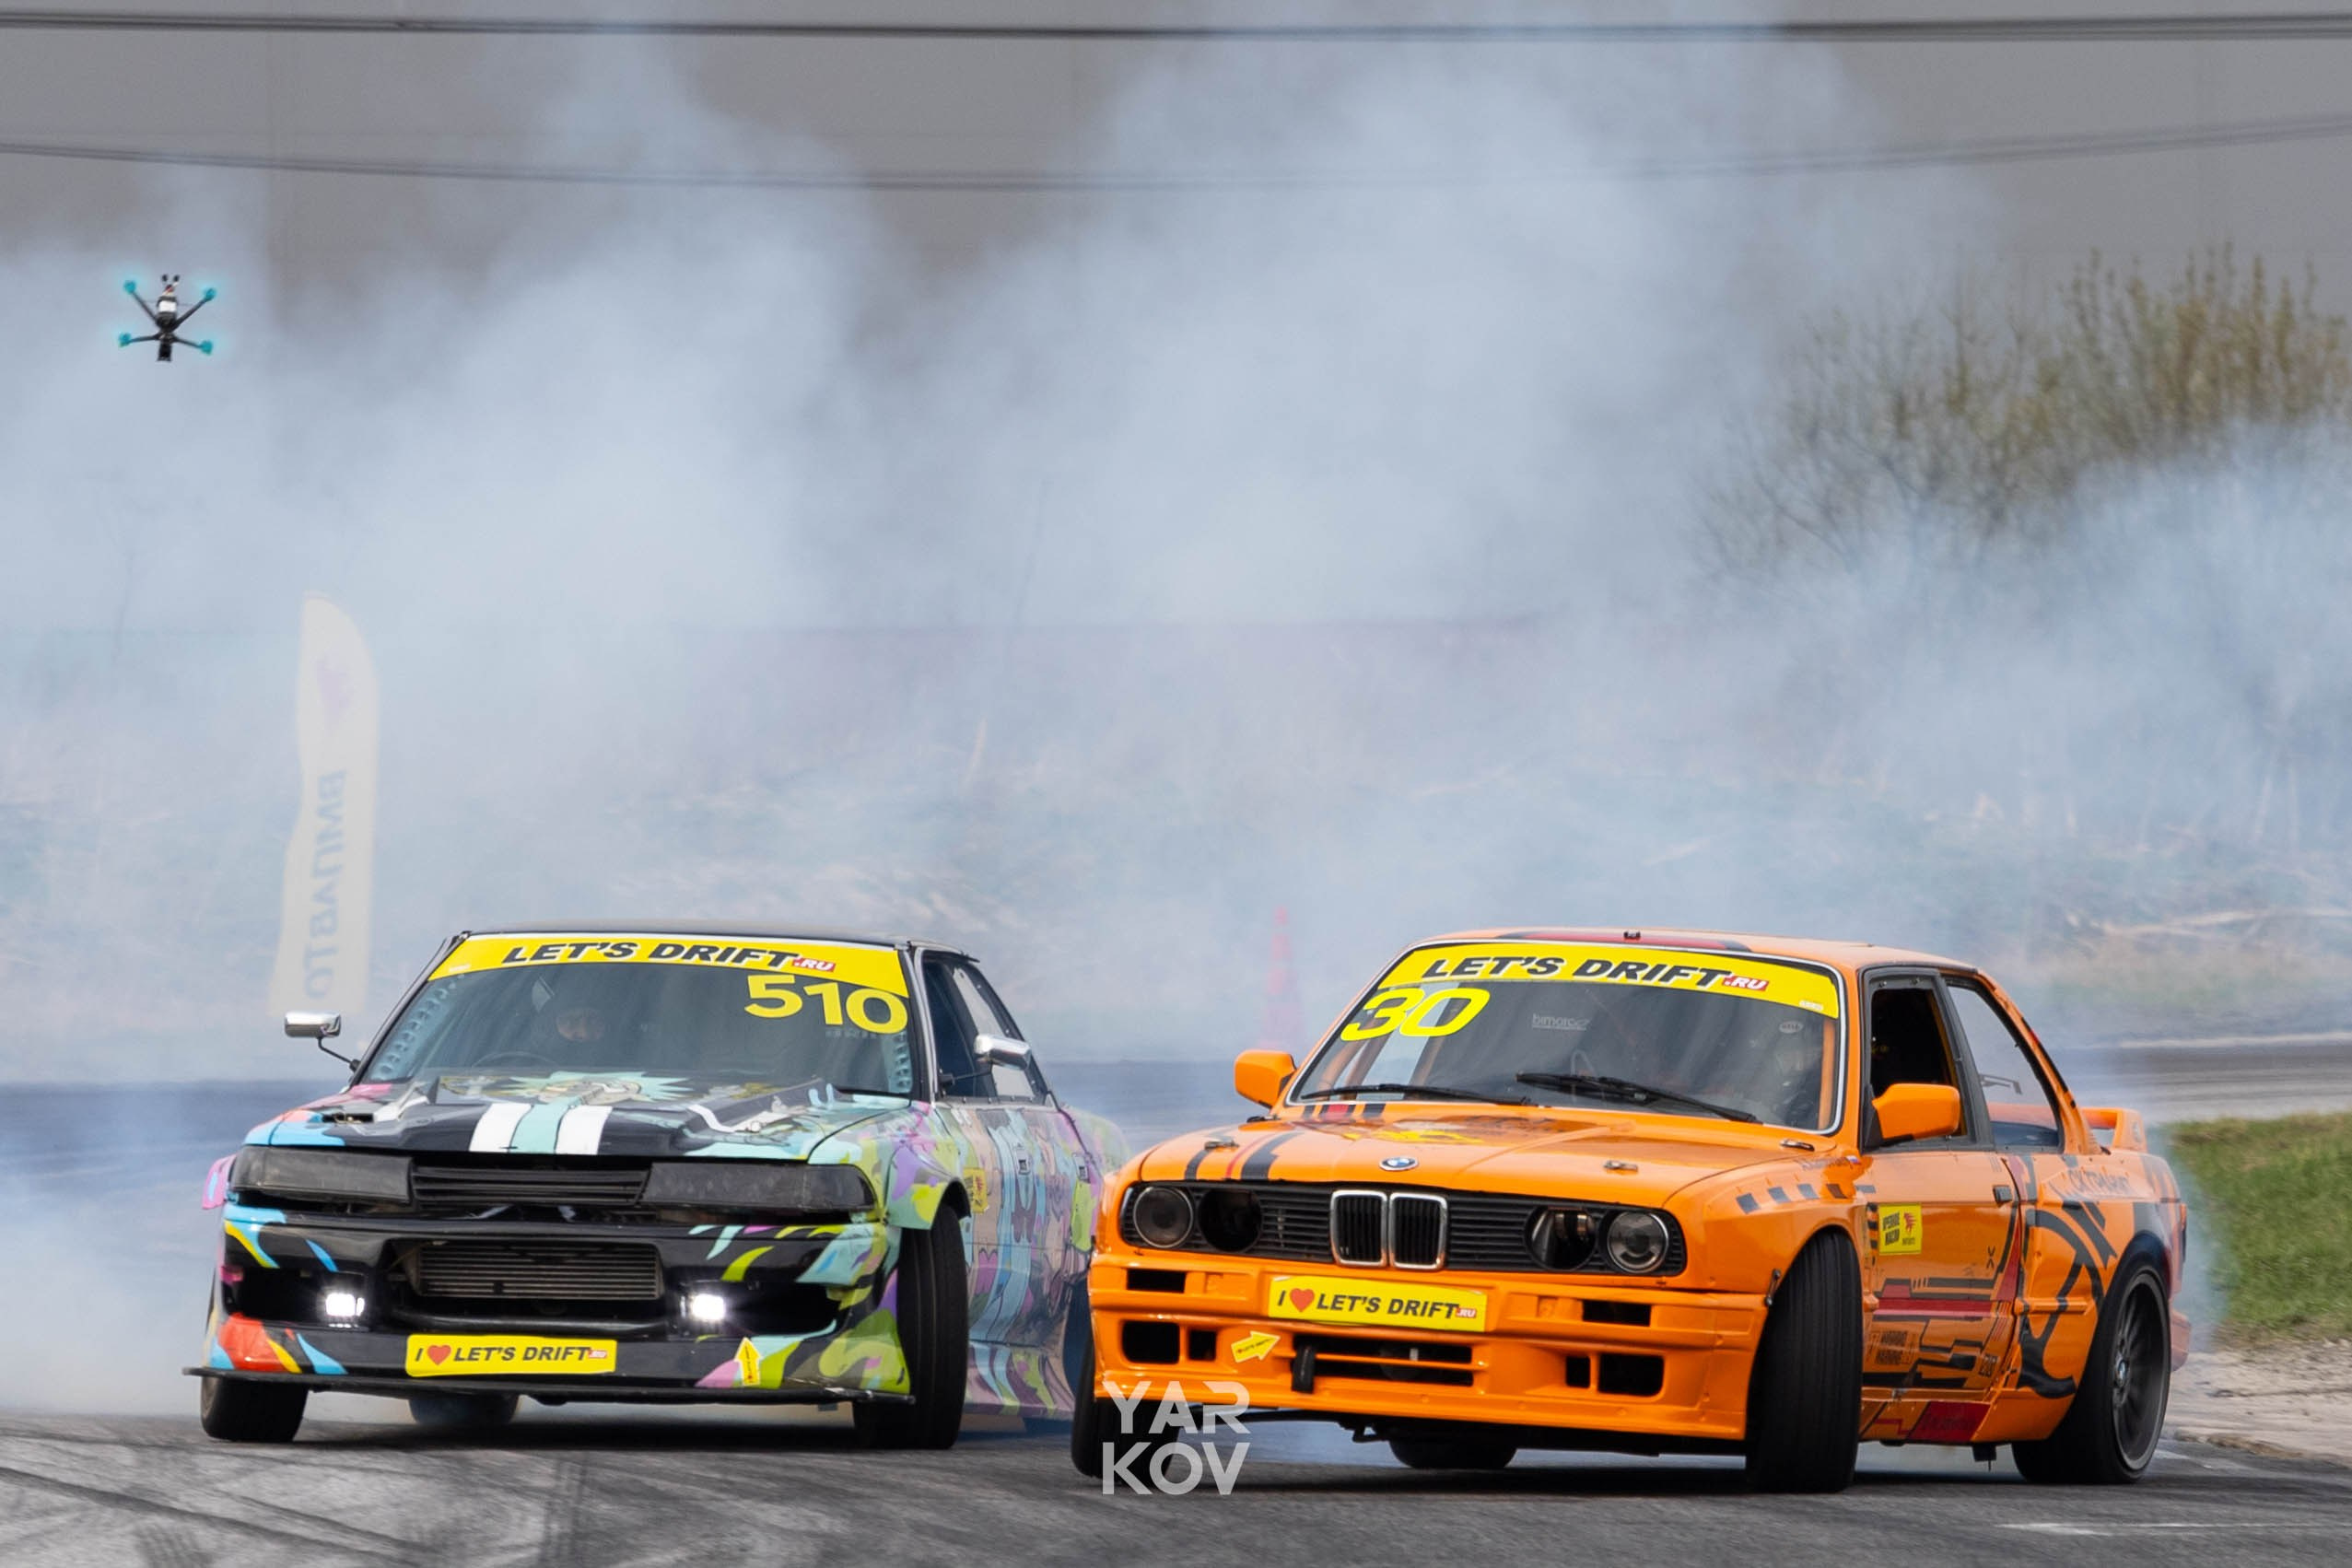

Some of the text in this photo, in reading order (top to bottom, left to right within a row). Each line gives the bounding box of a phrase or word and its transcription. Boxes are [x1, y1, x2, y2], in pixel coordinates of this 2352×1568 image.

[502, 942, 638, 964] LET'S
[1422, 957, 1565, 978] LET'S
[744, 974, 908, 1034] 510
[1340, 988, 1491, 1041] 30
[1277, 1290, 1285, 1308] I
[1316, 1293, 1381, 1313] LET'S
[415, 1348, 423, 1363] I
[453, 1347, 515, 1362] LET'S
